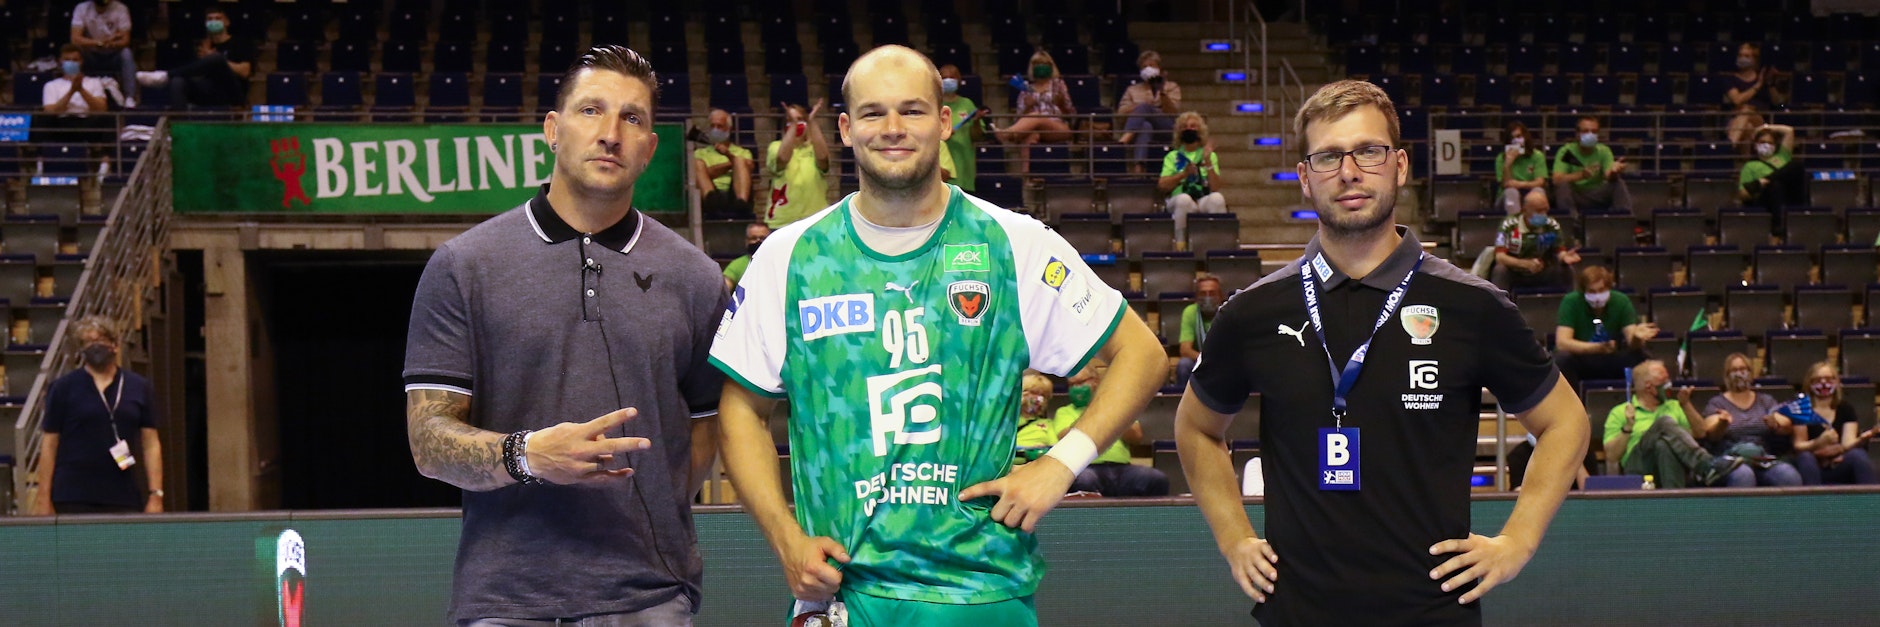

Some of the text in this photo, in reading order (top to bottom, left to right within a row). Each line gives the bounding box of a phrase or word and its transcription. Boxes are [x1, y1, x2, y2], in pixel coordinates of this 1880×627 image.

[1442, 142, 1455, 161] D
[952, 250, 982, 262] AOK
[1315, 256, 1330, 279] DKB
[1304, 280, 1317, 308] MOLY
[801, 300, 869, 335] DKB
[882, 307, 929, 368] 95
[1401, 394, 1443, 402] DEUTSCHE
[1404, 402, 1439, 410] WOHNEN
[1327, 433, 1350, 466] B
